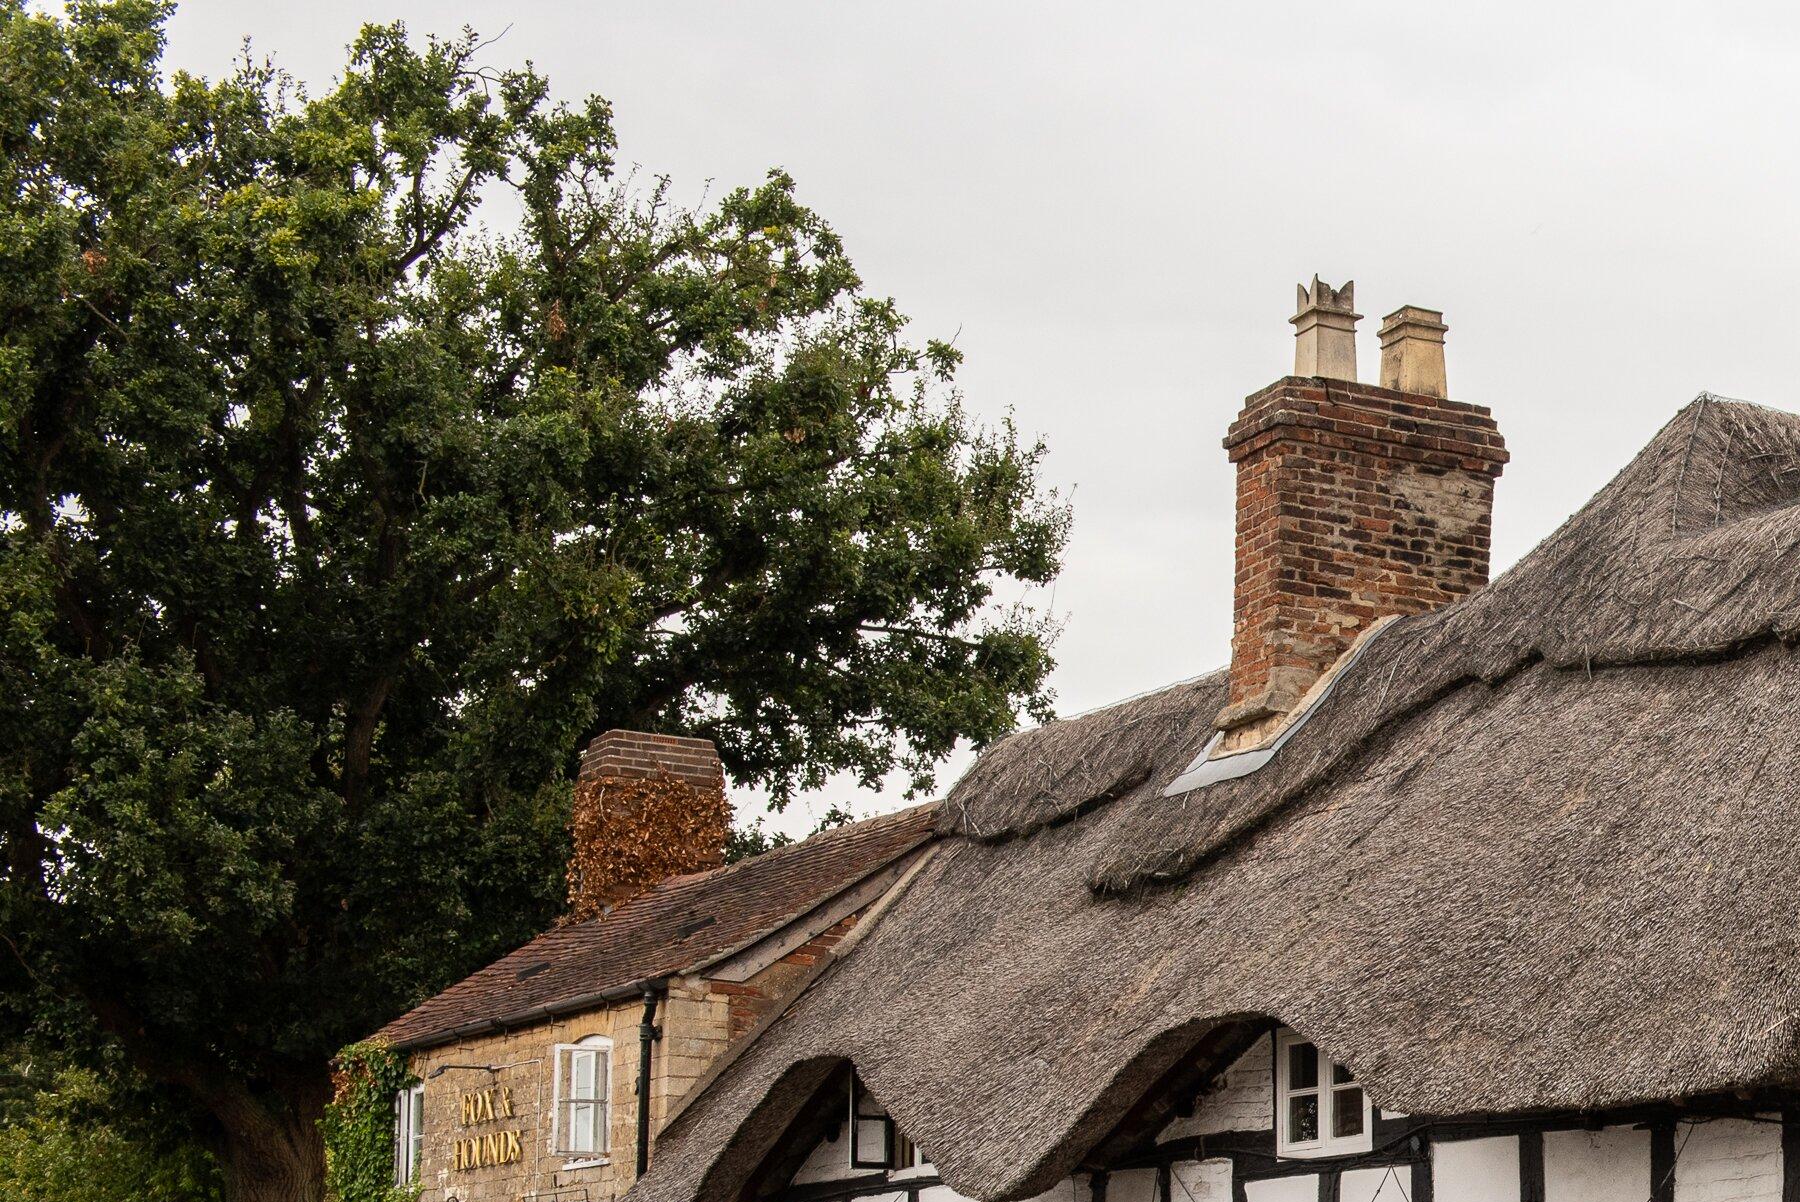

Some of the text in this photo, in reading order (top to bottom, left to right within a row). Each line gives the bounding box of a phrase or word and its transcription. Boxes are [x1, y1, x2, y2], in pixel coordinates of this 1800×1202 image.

[462, 1087, 513, 1125] FOX &
[454, 1130, 521, 1170] HOUNDS
